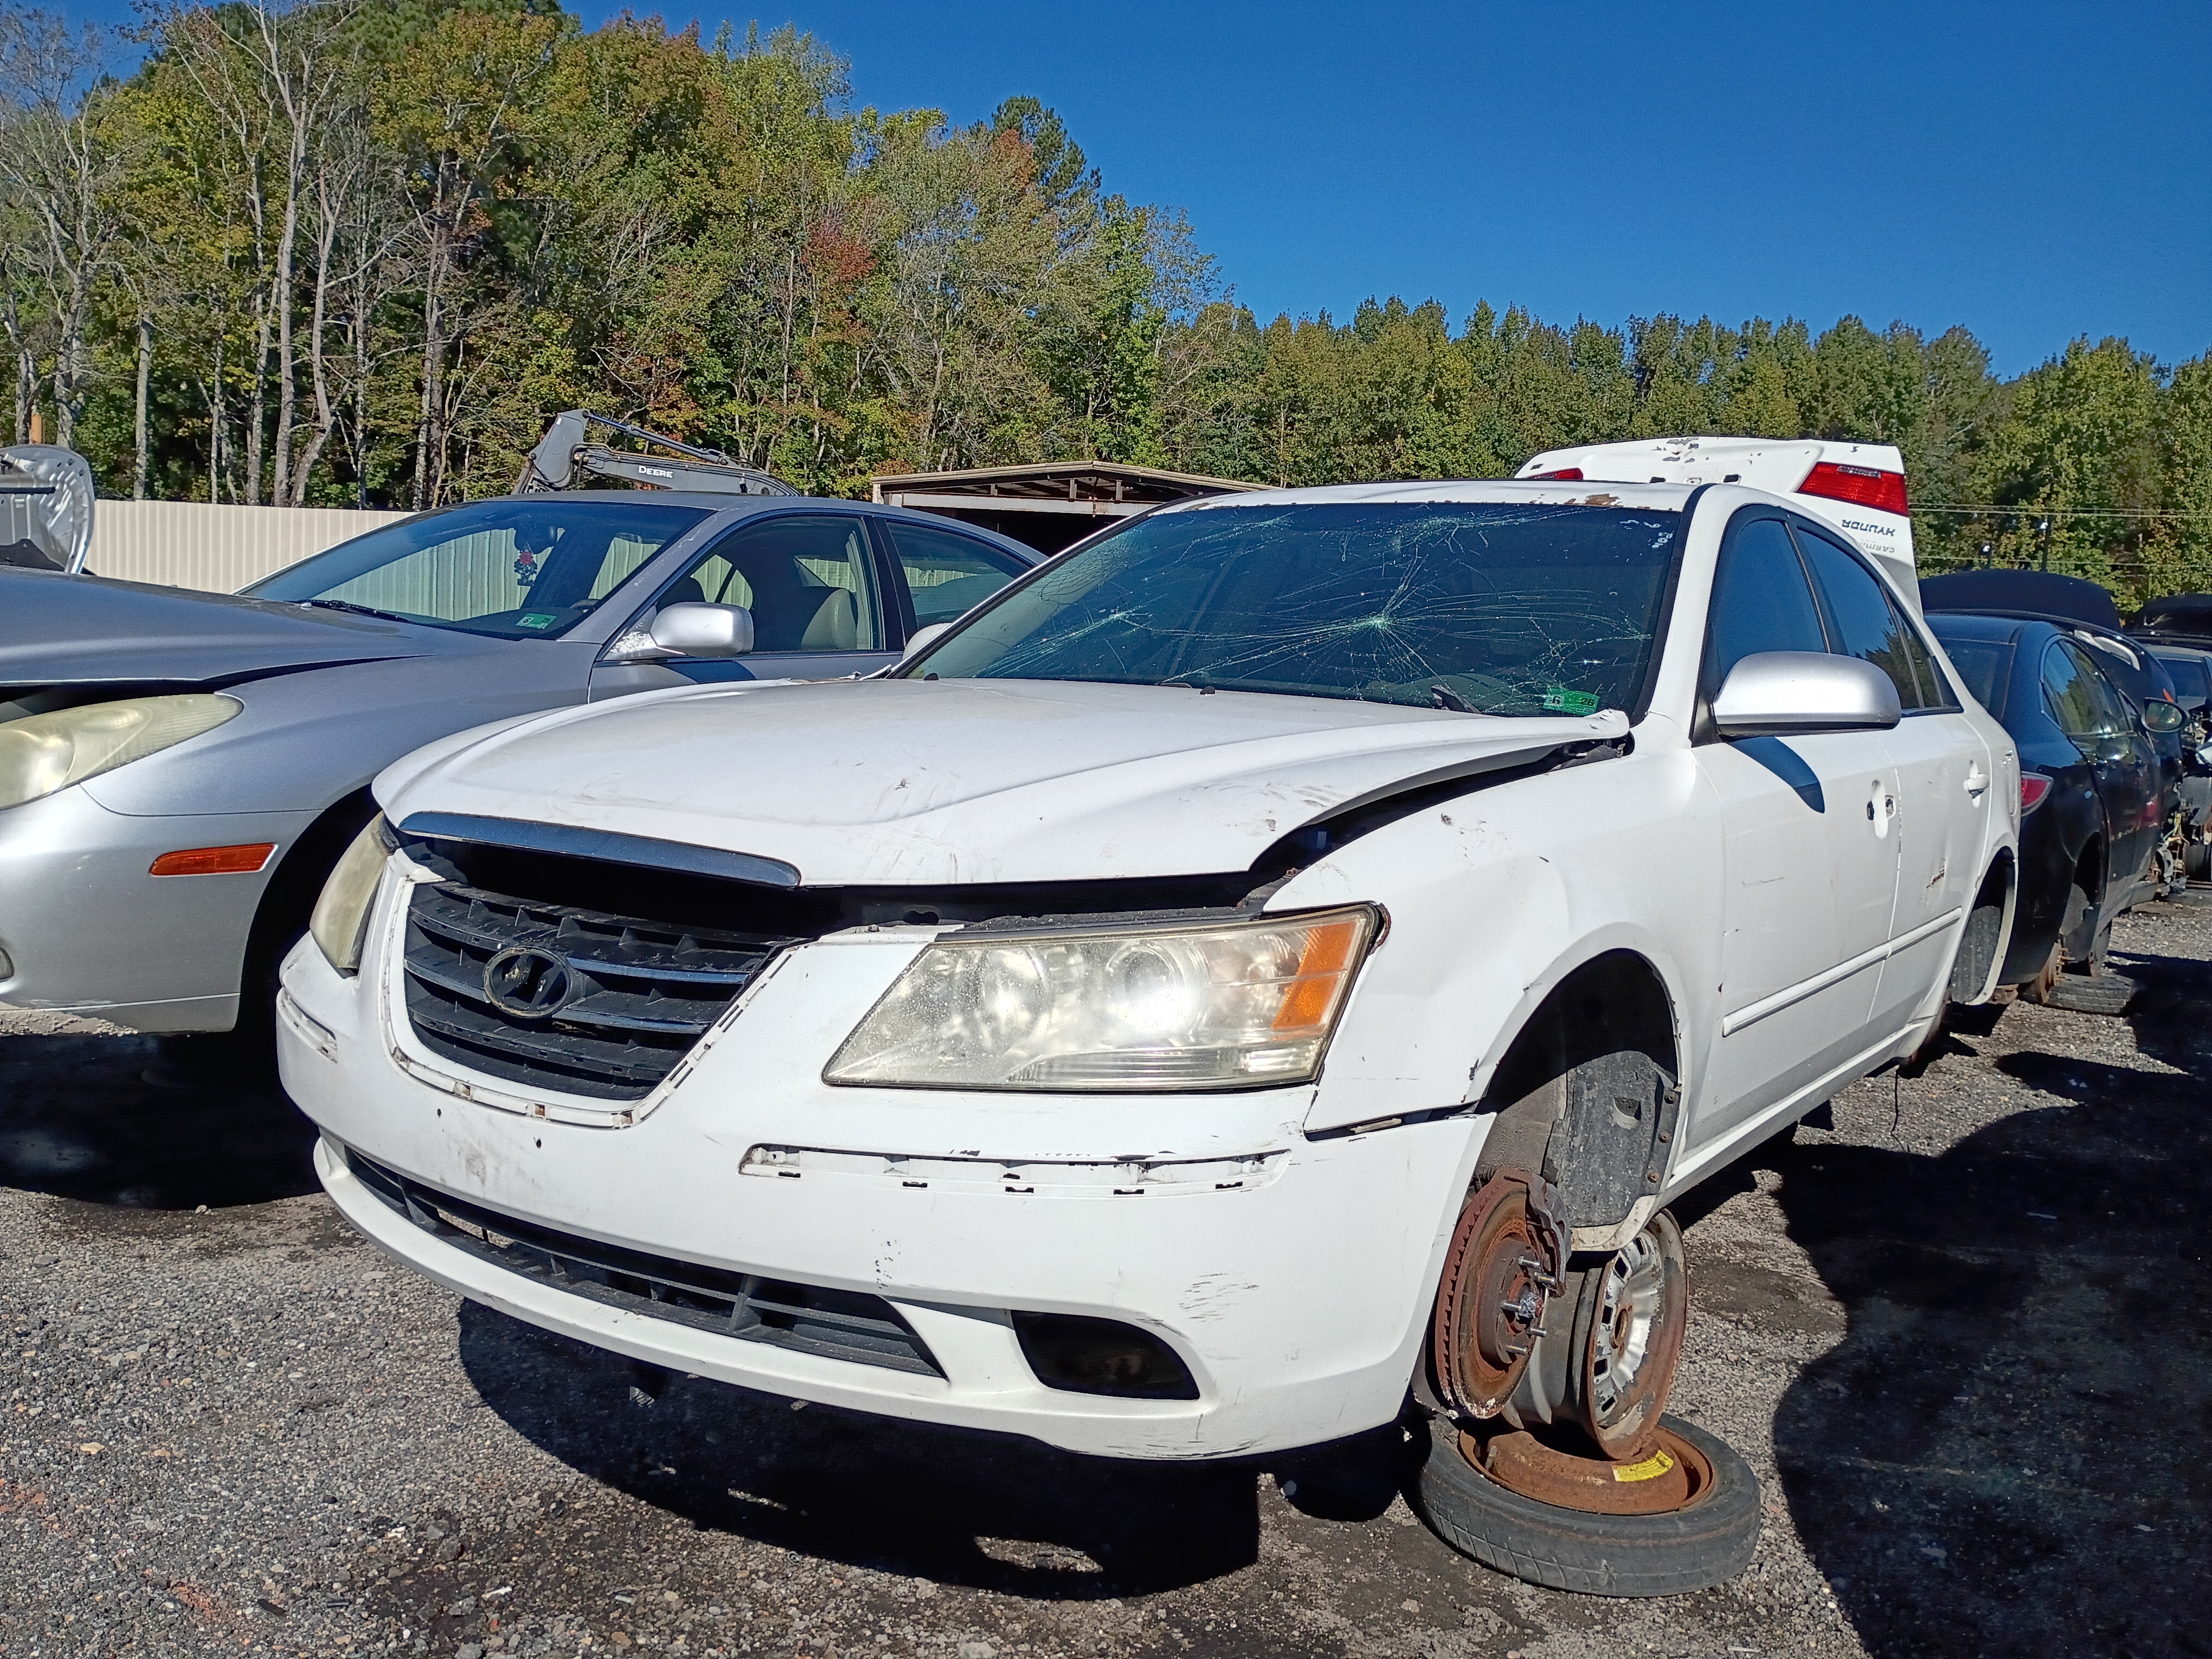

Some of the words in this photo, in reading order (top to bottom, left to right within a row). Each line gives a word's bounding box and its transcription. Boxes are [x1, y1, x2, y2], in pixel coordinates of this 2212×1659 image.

[639, 465, 673, 478] DEERE
[1552, 695, 1561, 704] 6
[1580, 697, 1594, 706] 26
